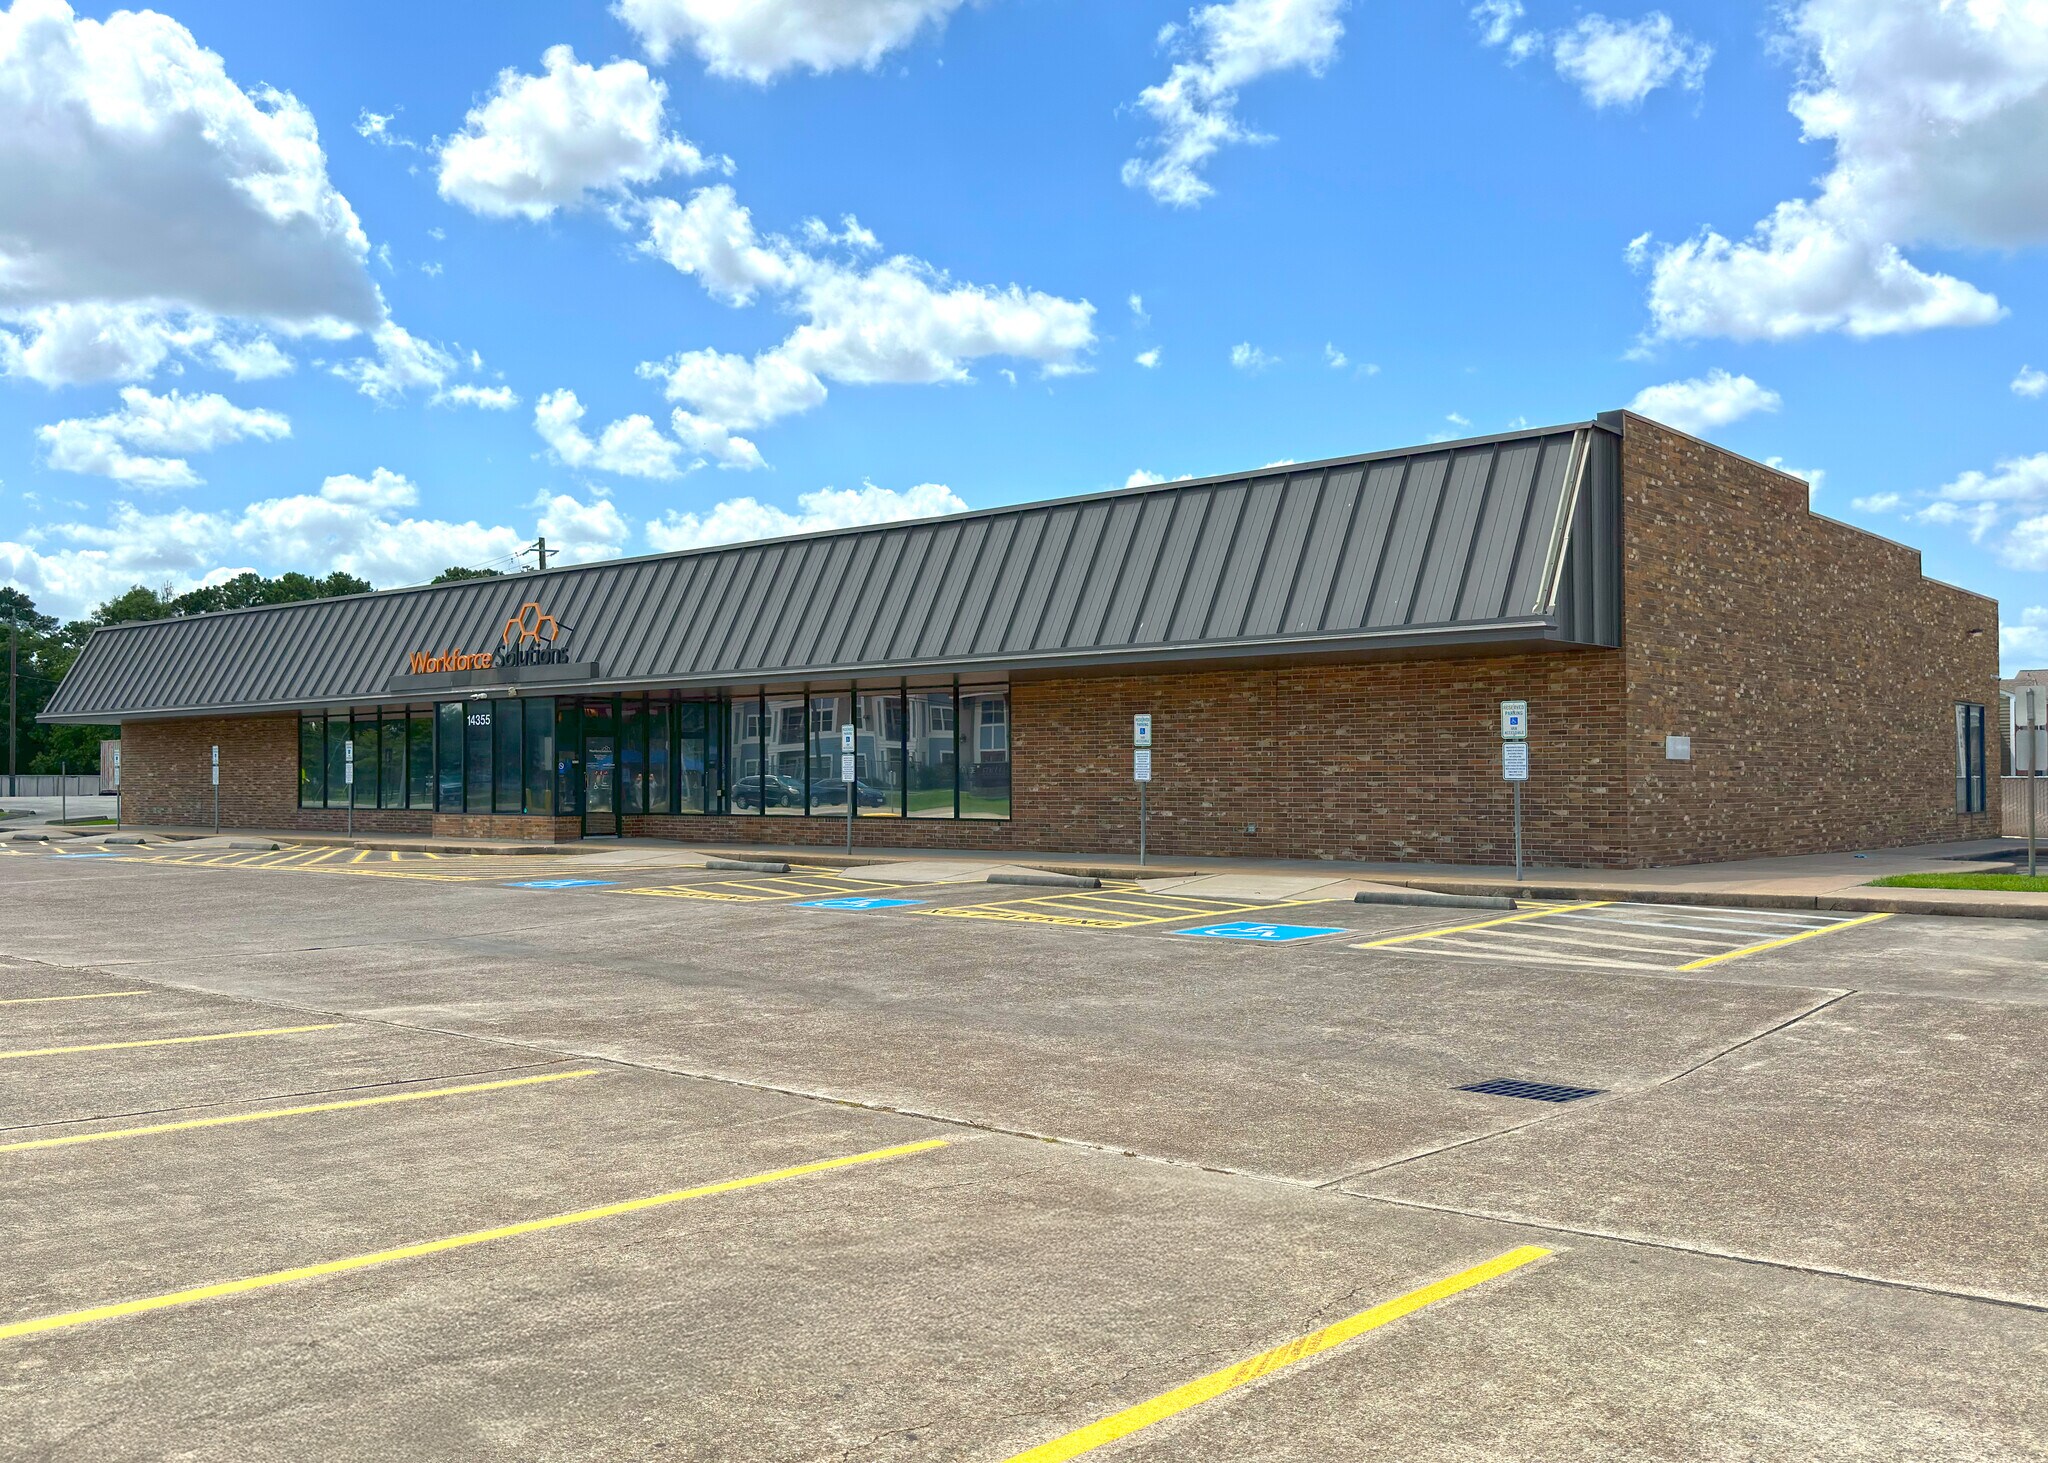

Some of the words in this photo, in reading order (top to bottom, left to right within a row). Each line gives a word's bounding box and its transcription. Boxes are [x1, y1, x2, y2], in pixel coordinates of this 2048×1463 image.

[410, 648, 493, 675] Workforce
[495, 643, 570, 668] Solutions
[467, 714, 491, 726] 14355
